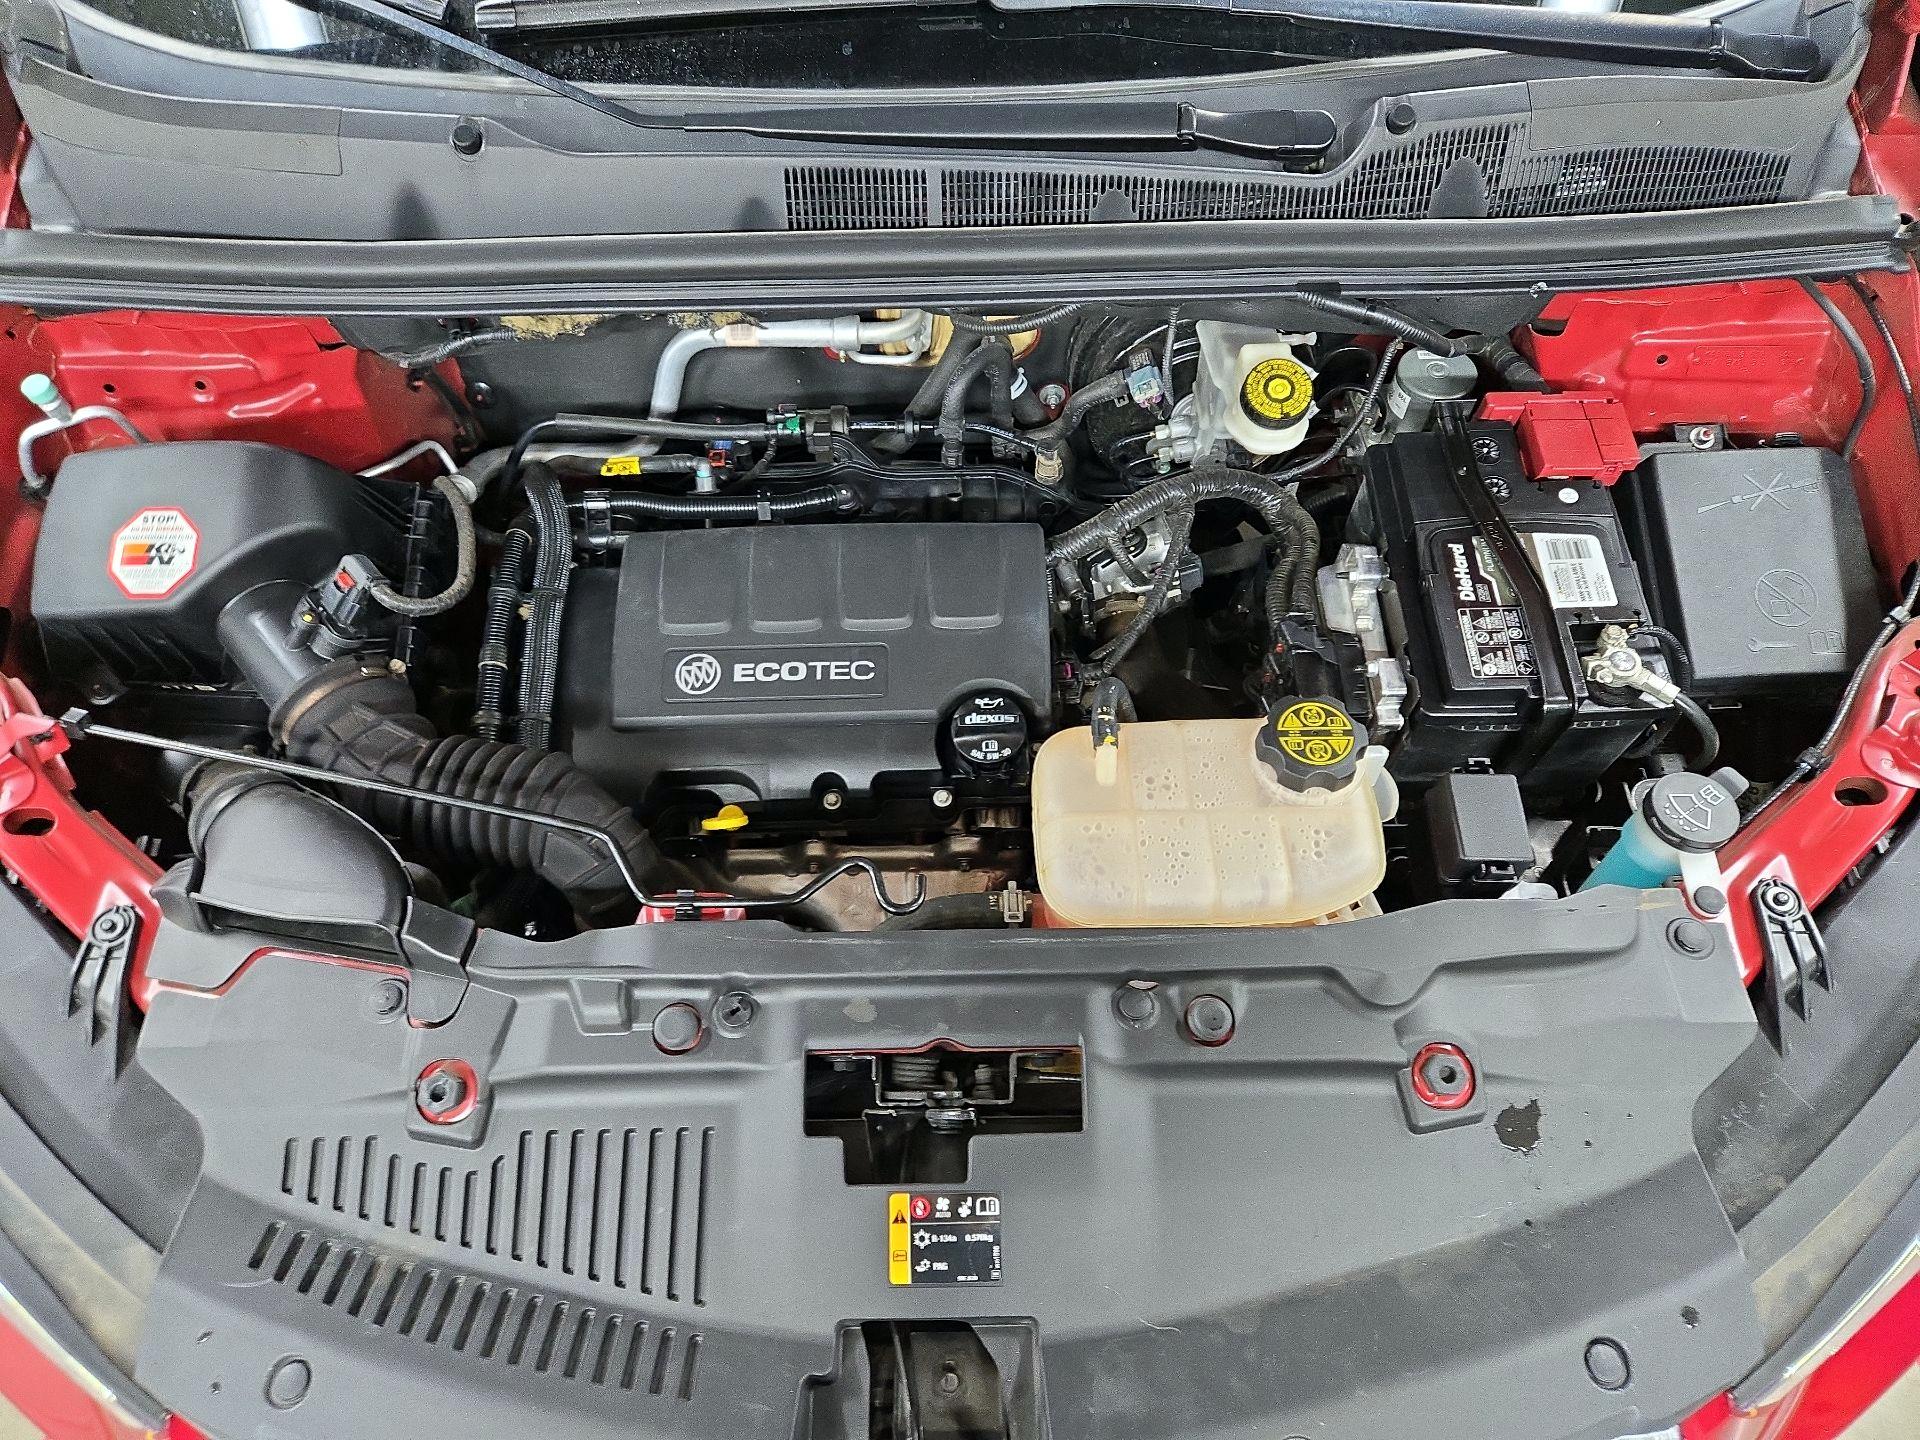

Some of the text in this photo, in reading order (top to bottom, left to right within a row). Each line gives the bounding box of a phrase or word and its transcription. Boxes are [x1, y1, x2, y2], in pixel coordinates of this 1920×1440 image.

[1447, 543, 1477, 602] DieHard
[733, 660, 876, 682] ECOTEC
[964, 712, 1015, 725] dexos
